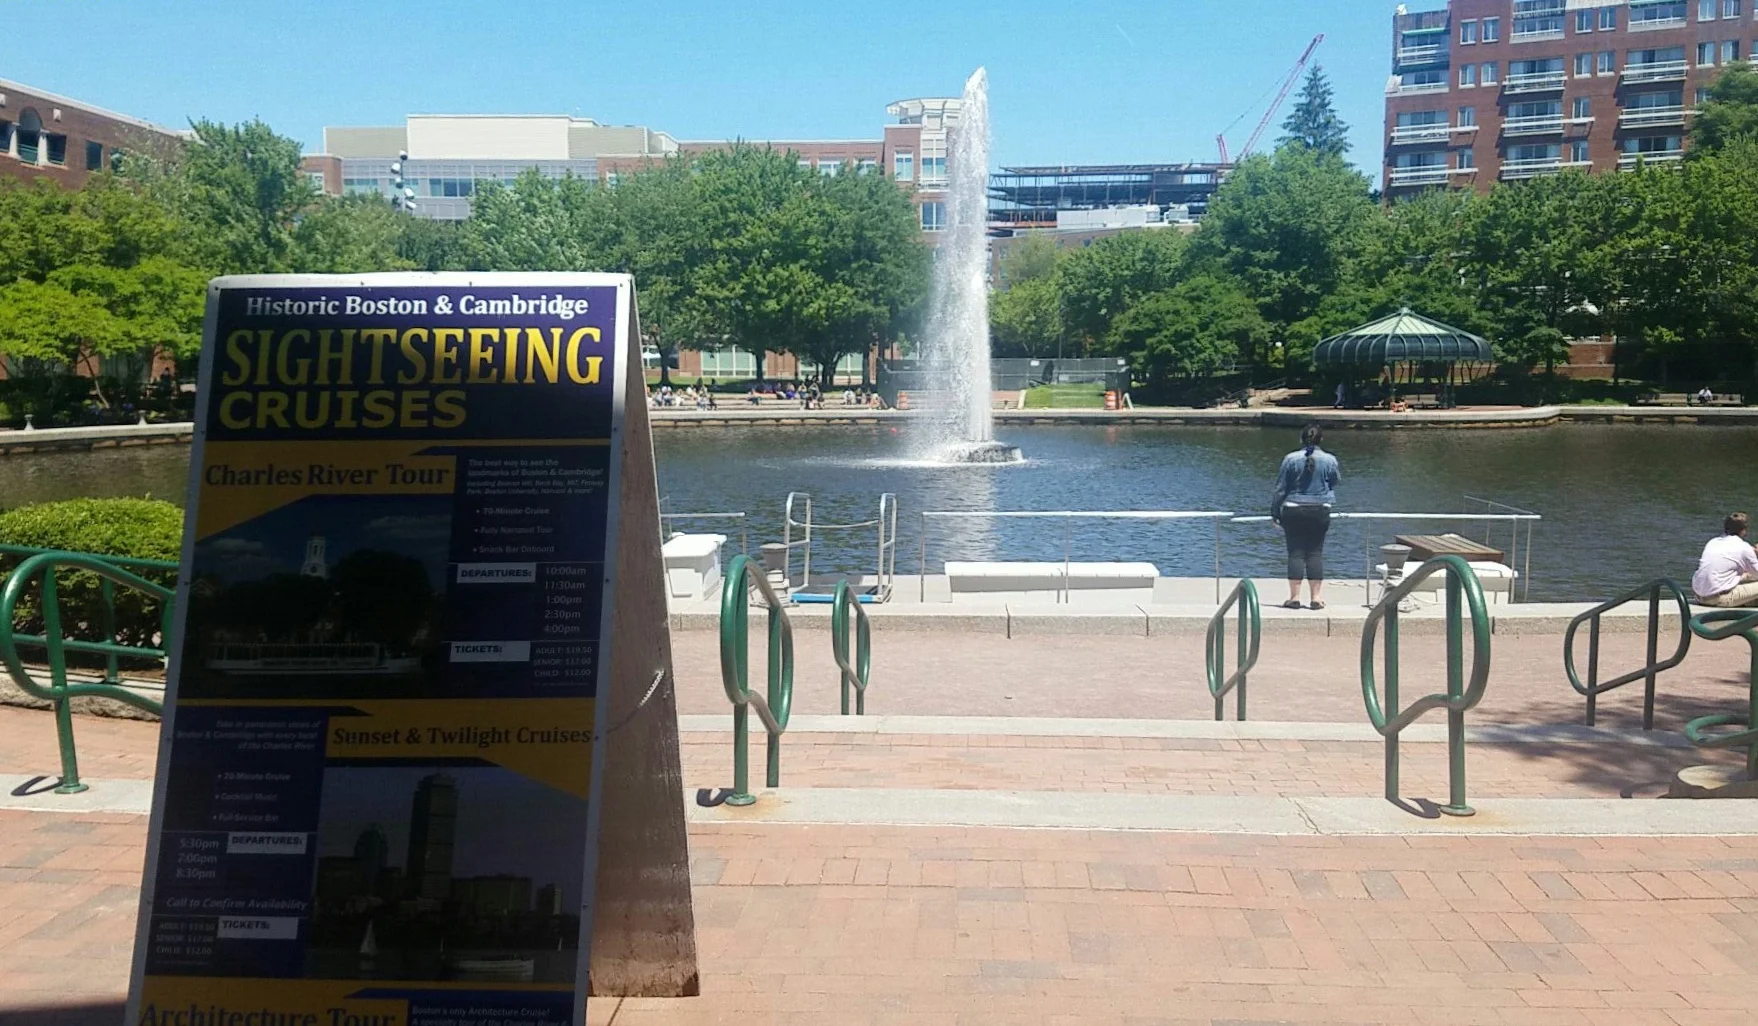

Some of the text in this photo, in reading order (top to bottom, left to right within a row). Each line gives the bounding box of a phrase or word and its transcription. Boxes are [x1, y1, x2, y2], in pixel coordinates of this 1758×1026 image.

[247, 294, 589, 320] Historic Boston & Cambridge
[222, 326, 603, 386] SIGHTSEEING
[219, 390, 467, 429] CRUISES
[206, 463, 449, 486] Charles River Tour
[558, 468, 603, 477] Cambridge!
[483, 507, 550, 515] 70-Minute Cruise
[480, 526, 554, 536] Fully Narrated Tour
[461, 568, 531, 577] DEPARTURES:
[546, 567, 586, 576] 10:00am
[545, 581, 585, 590] 11:30am
[546, 595, 582, 605] 1:00pm
[544, 609, 581, 620] 2:30pm
[543, 624, 580, 635] 4:00pm
[455, 645, 502, 653] TICKETS:
[565, 669, 591, 677] $12.00
[333, 726, 592, 748] Sunset & Twilight Cruises
[223, 772, 291, 781] 70-Minute Cruise
[180, 838, 219, 850] 5:30pm
[232, 836, 303, 845] DEPARTURES:
[178, 853, 218, 865] 7:00pm
[176, 868, 216, 880] 8:30pm
[166, 897, 308, 911] Call to Confirm Availability
[223, 920, 270, 929] TICKETS:
[140, 1003, 396, 1026] Architecture Tour
